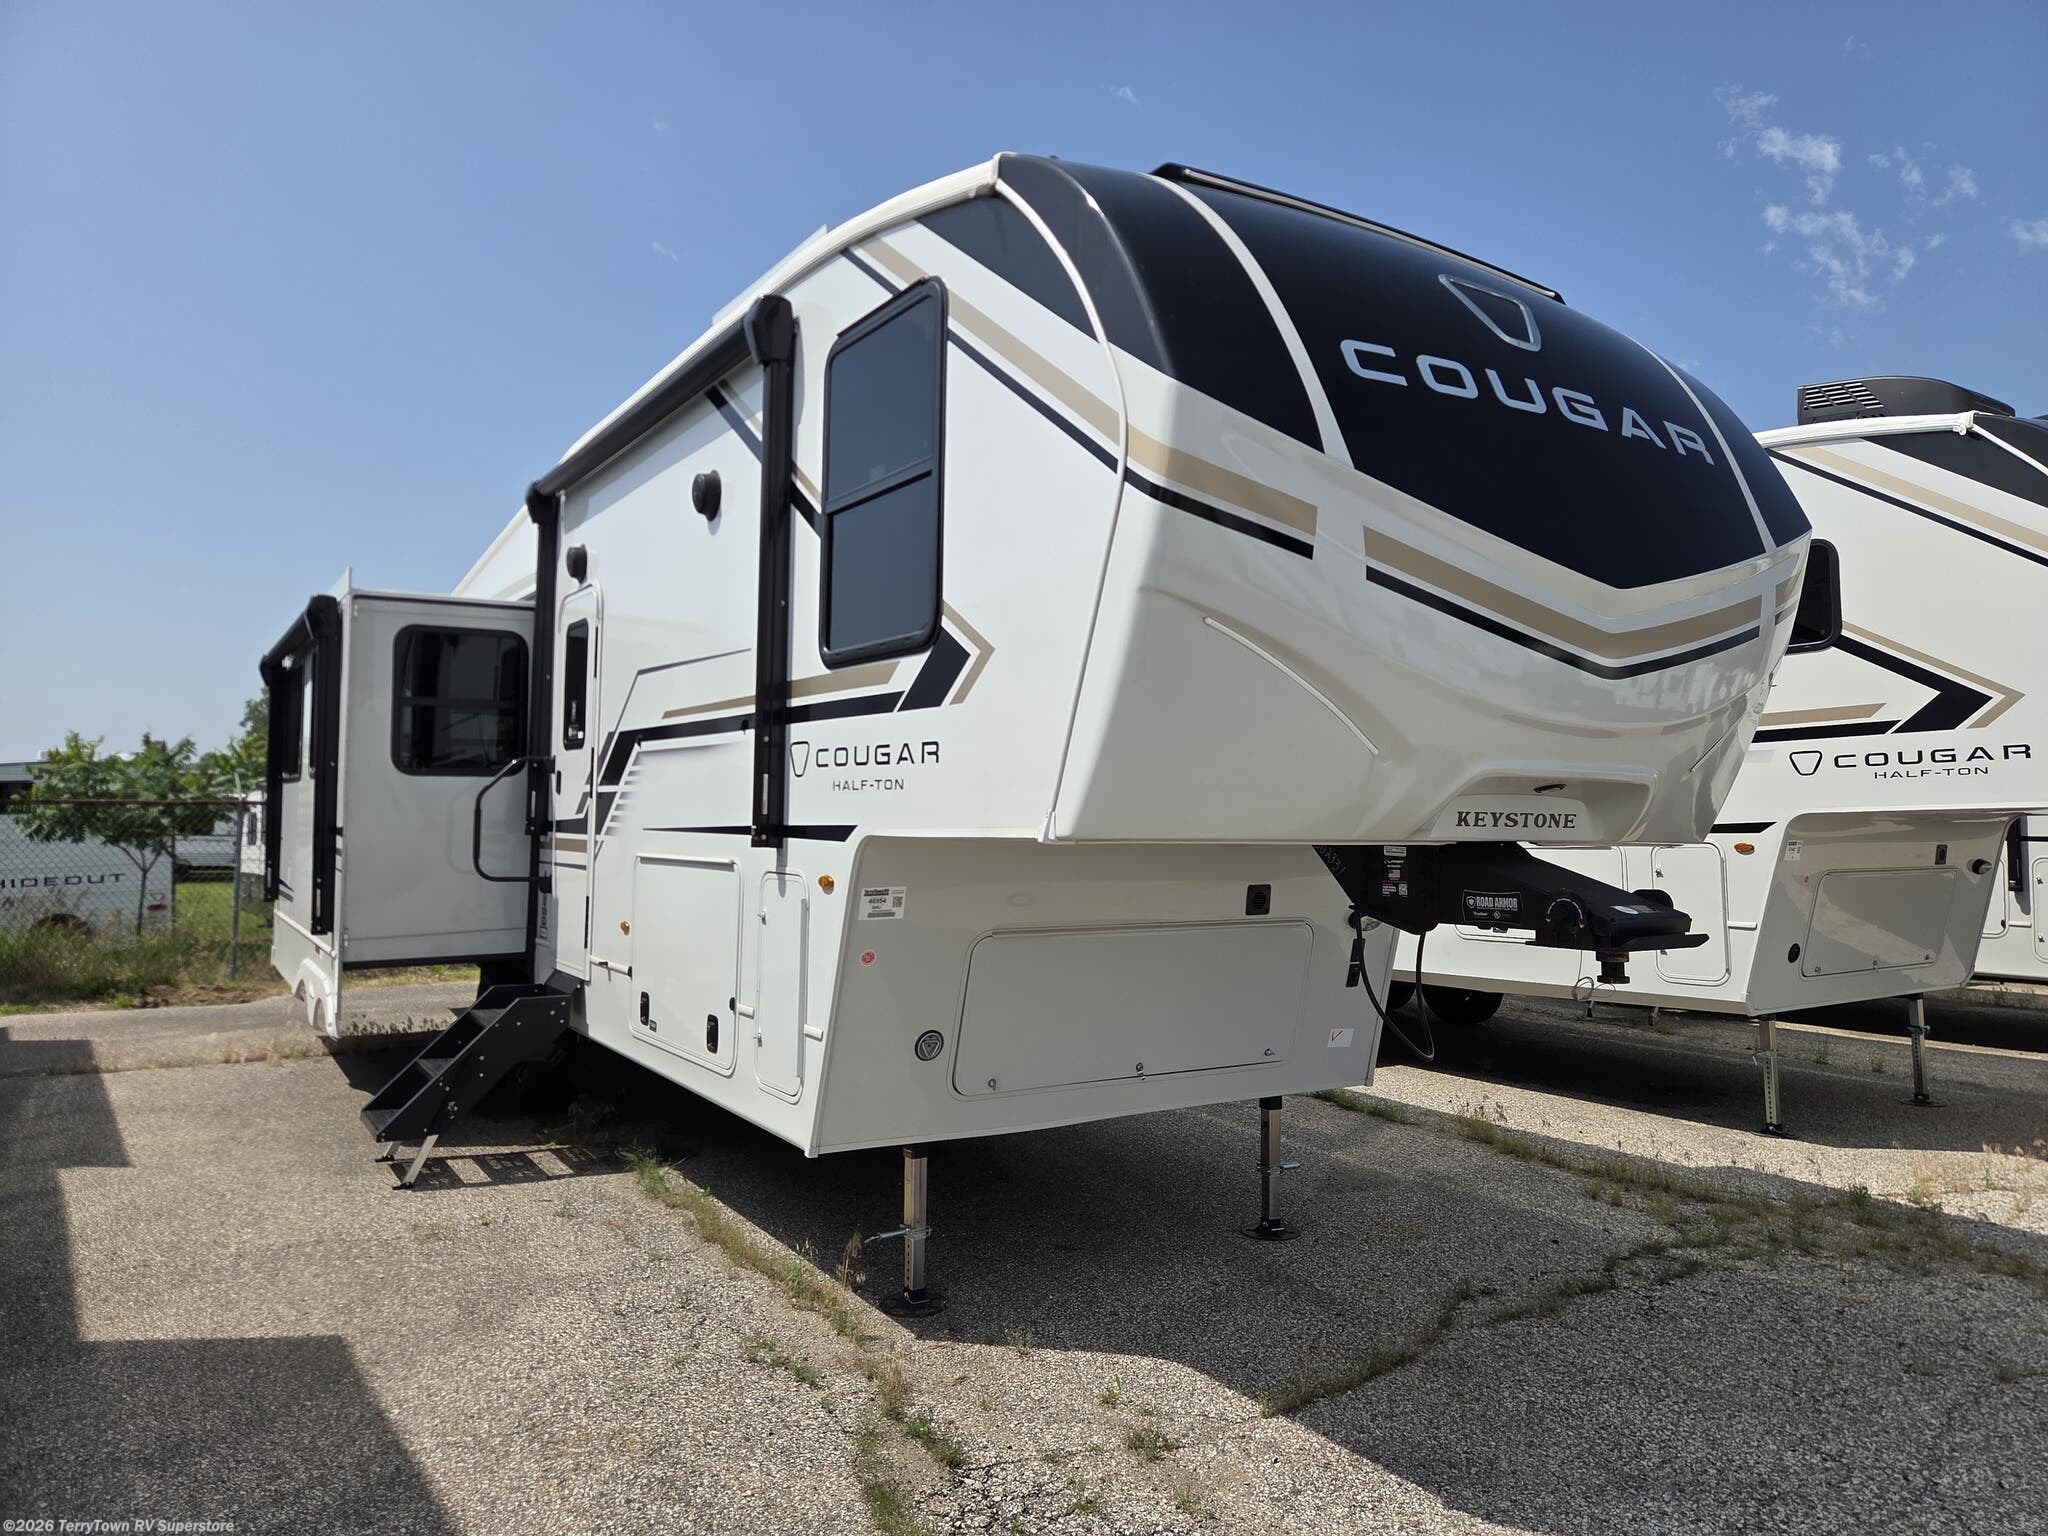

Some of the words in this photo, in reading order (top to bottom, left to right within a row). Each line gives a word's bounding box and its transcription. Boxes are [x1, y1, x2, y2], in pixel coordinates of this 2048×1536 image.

[1340, 339, 1715, 465] COUGAR
[815, 741, 940, 768] COUGAR
[1833, 743, 2032, 768] COUGAR
[1874, 766, 1989, 780] HALF-TON
[832, 778, 905, 791] HALF-TON
[1455, 810, 1577, 829] KEYSTONE
[1476, 896, 1494, 907] ROAD
[1494, 897, 1518, 908] ARMOR
